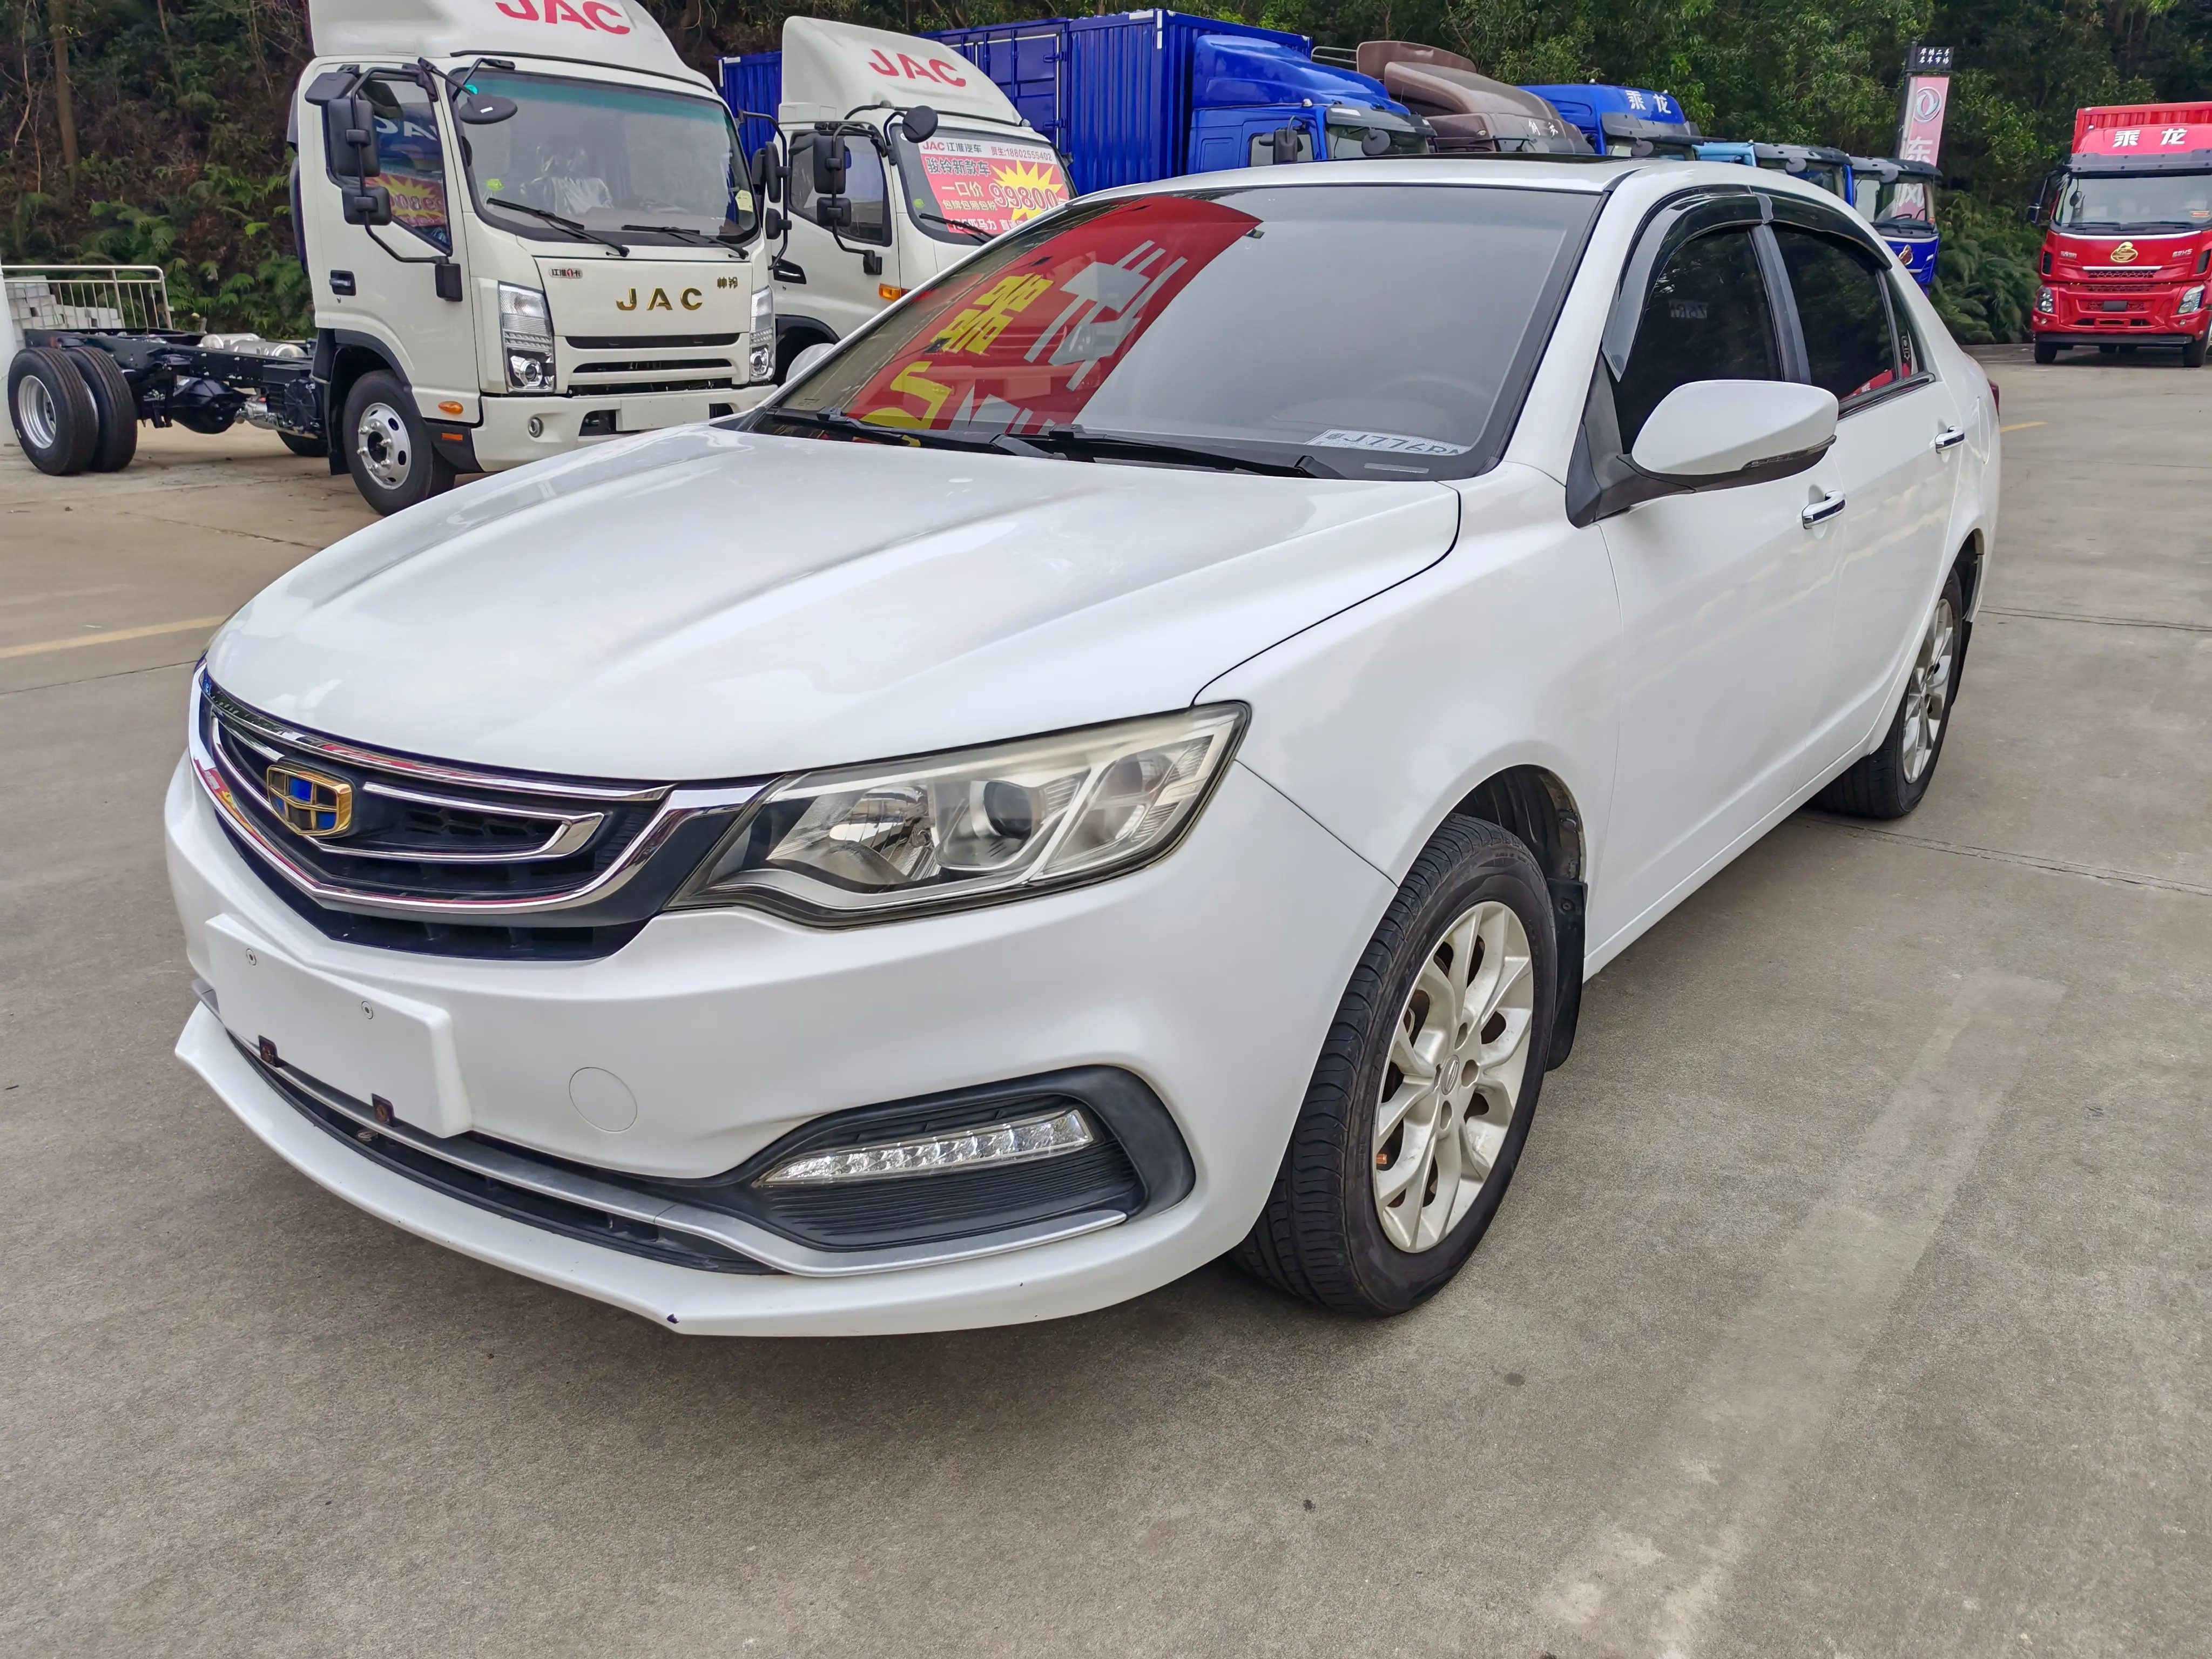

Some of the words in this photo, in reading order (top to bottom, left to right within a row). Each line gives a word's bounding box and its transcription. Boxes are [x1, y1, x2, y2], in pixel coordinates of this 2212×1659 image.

[495, 0, 630, 35] JAC
[867, 49, 967, 87] JAC
[1624, 89, 1672, 114] 乘龙
[922, 141, 945, 151] JAC
[946, 141, 982, 153] 江淮汽车
[2113, 127, 2188, 147] 乘龙
[925, 157, 992, 177] 骏铃新款车
[941, 180, 985, 198] 一口价
[616, 287, 703, 311] JAC
